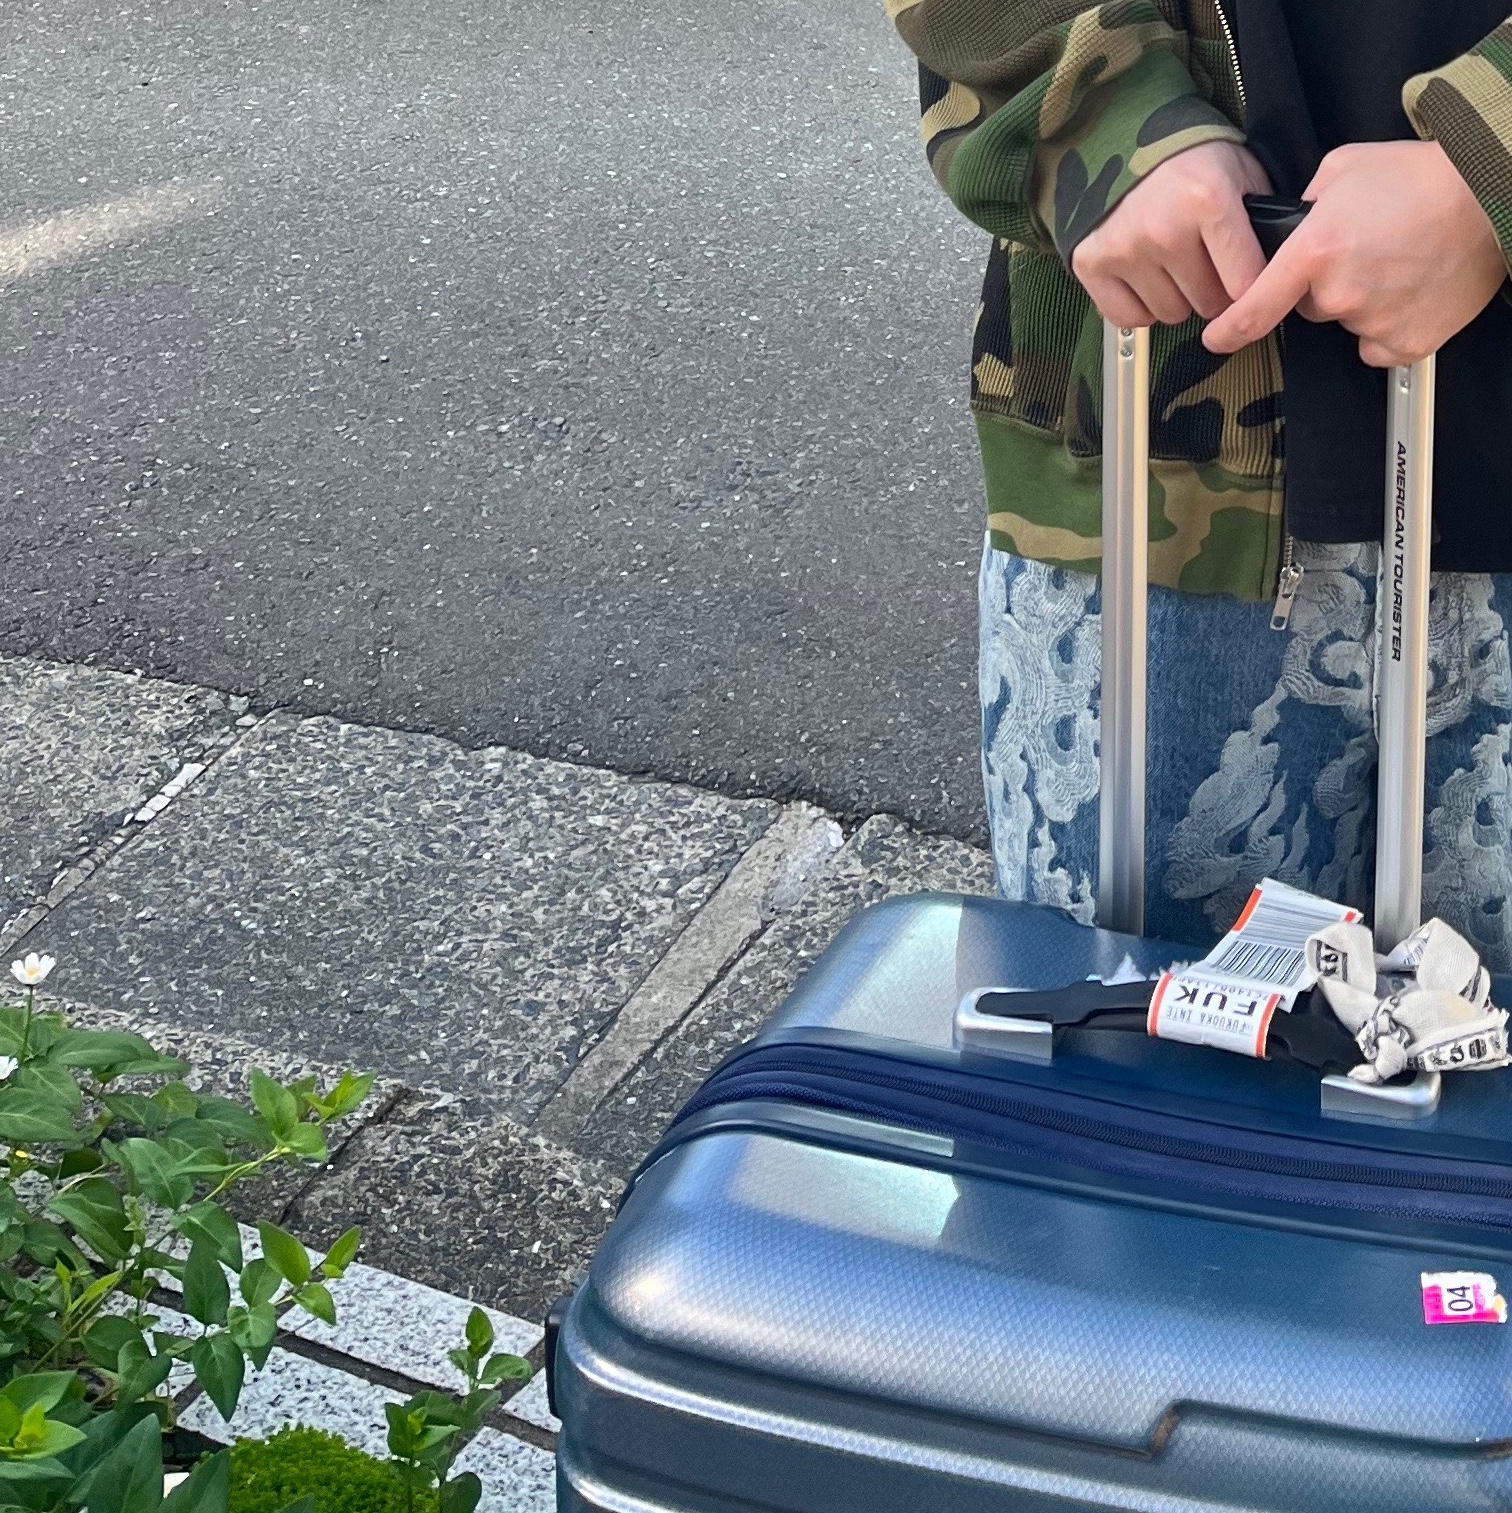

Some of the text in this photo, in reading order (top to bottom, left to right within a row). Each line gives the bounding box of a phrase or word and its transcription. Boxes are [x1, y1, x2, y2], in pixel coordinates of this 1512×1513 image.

[1391, 441, 1407, 663] AMERICAN TOURISTER
[1174, 985, 1257, 1017] FUK
[1198, 1012, 1248, 1034] FUKUOKA
[1446, 1285, 1474, 1312] 04
